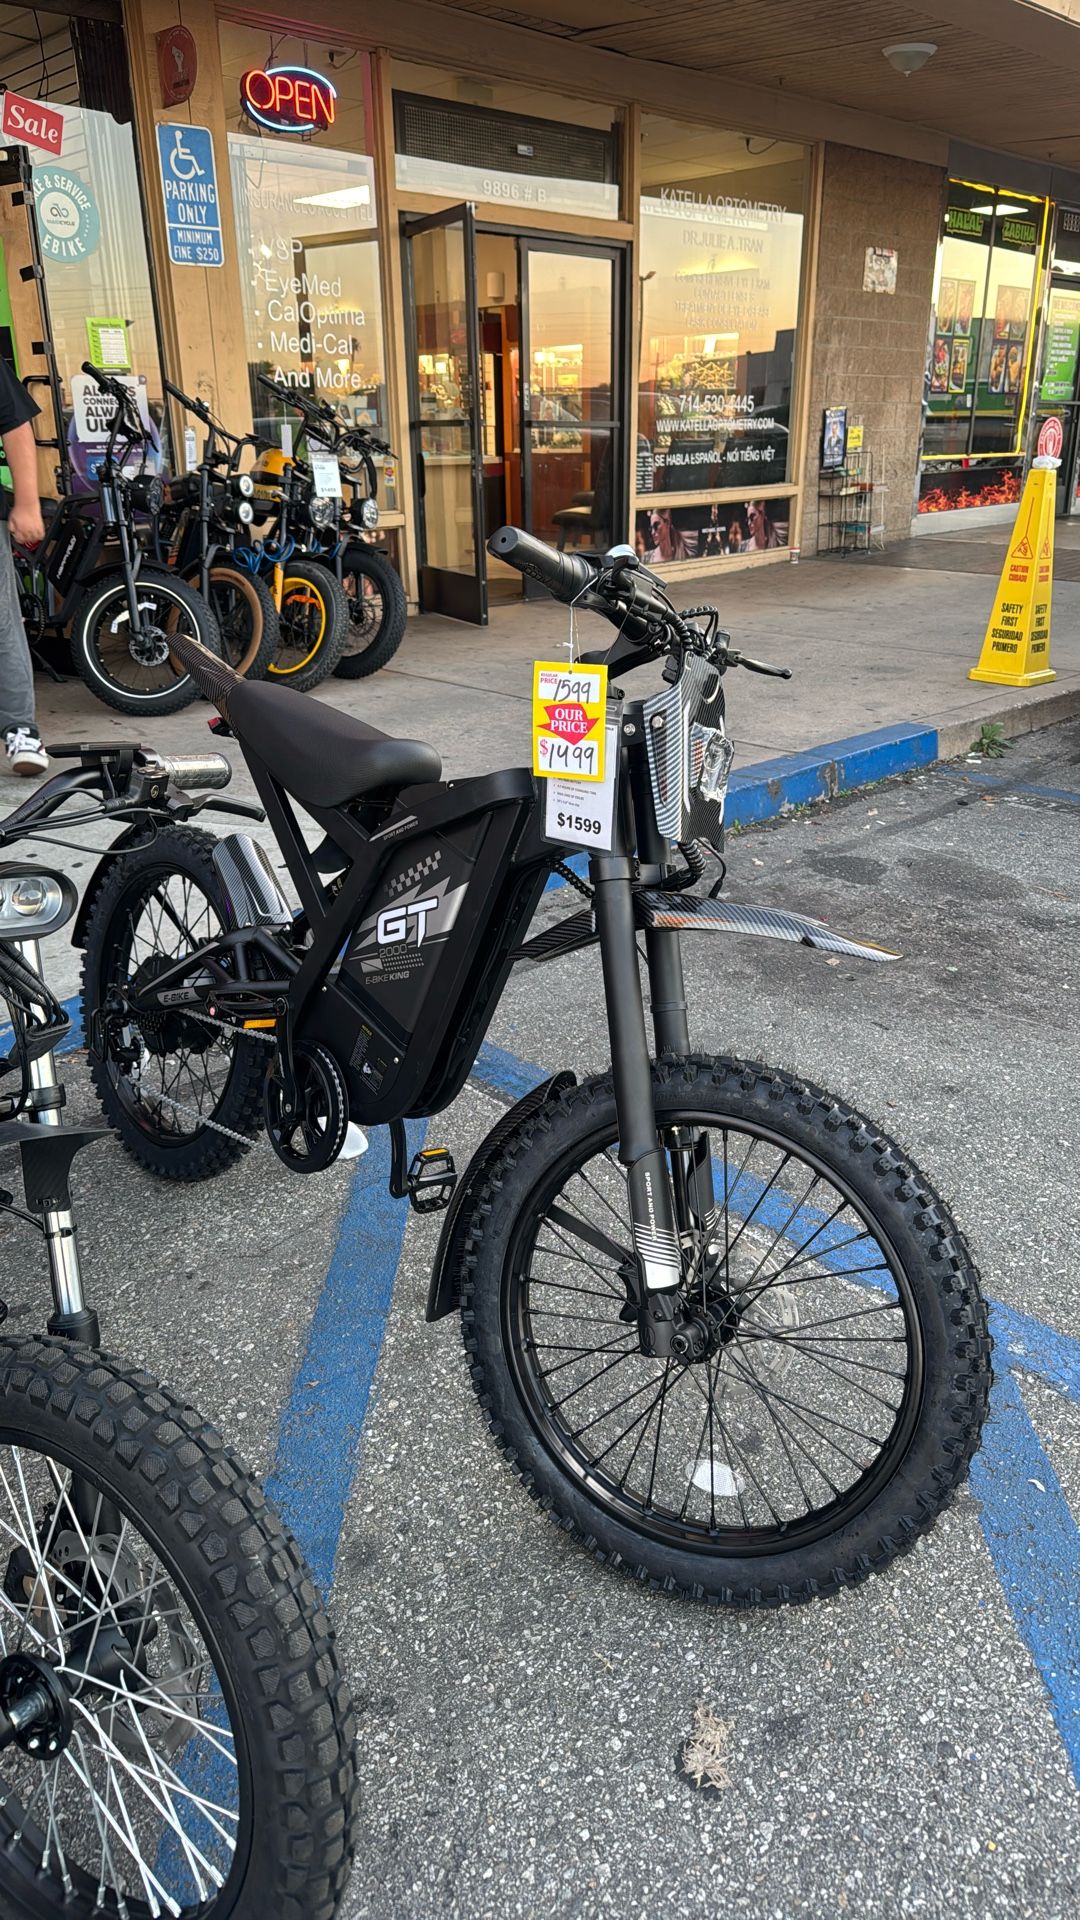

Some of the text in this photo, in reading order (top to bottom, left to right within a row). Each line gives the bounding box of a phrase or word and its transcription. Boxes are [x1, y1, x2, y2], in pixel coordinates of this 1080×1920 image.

[246, 69, 335, 124] OPEN
[7, 104, 59, 143] Sale
[43, 175, 53, 188] &
[54, 175, 91, 211] SERVICE
[165, 180, 215, 204] PARKING
[483, 179, 547, 203] 9896 # B
[178, 205, 207, 224] ONLY
[660, 187, 713, 213] KATELLA
[715, 195, 787, 224] OPTOMETRY
[949, 210, 982, 232] HALAL
[1003, 221, 1036, 242] ZABIHA
[42, 234, 86, 256] EBIKE
[176, 230, 213, 245] MINIMUM
[260, 236, 303, 260] VSP
[174, 245, 219, 261] FINE $250
[264, 270, 341, 298] EyeMed
[268, 300, 365, 327] CalOptima
[270, 331, 352, 355] Medi-Cal
[274, 366, 377, 389] And More...
[679, 394, 755, 413] 714-530-4445
[656, 417, 775, 432] WWW.KATELLAOPTOMETRY.COM
[655, 454, 666, 467] SE
[666, 452, 691, 466] HABLA
[691, 450, 722, 464] ESPAÑOL
[1001, 602, 1023, 614] SAFETY
[1001, 616, 1018, 627] FIRST
[991, 628, 1023, 641] SEGURIDAD
[992, 641, 1018, 653] PRIMERO
[540, 677, 558, 685] PRICE
[553, 679, 592, 704] 1599
[555, 707, 583, 721] OUR
[550, 719, 588, 734] PRICE
[539, 738, 595, 775] $1499
[557, 812, 601, 835] $1599
[377, 896, 439, 948] GT
[379, 944, 407, 958] 2000
[163, 991, 189, 1003] E-BIKE
[644, 1171, 652, 1196] SPORT
[649, 1213, 657, 1241] POWER
